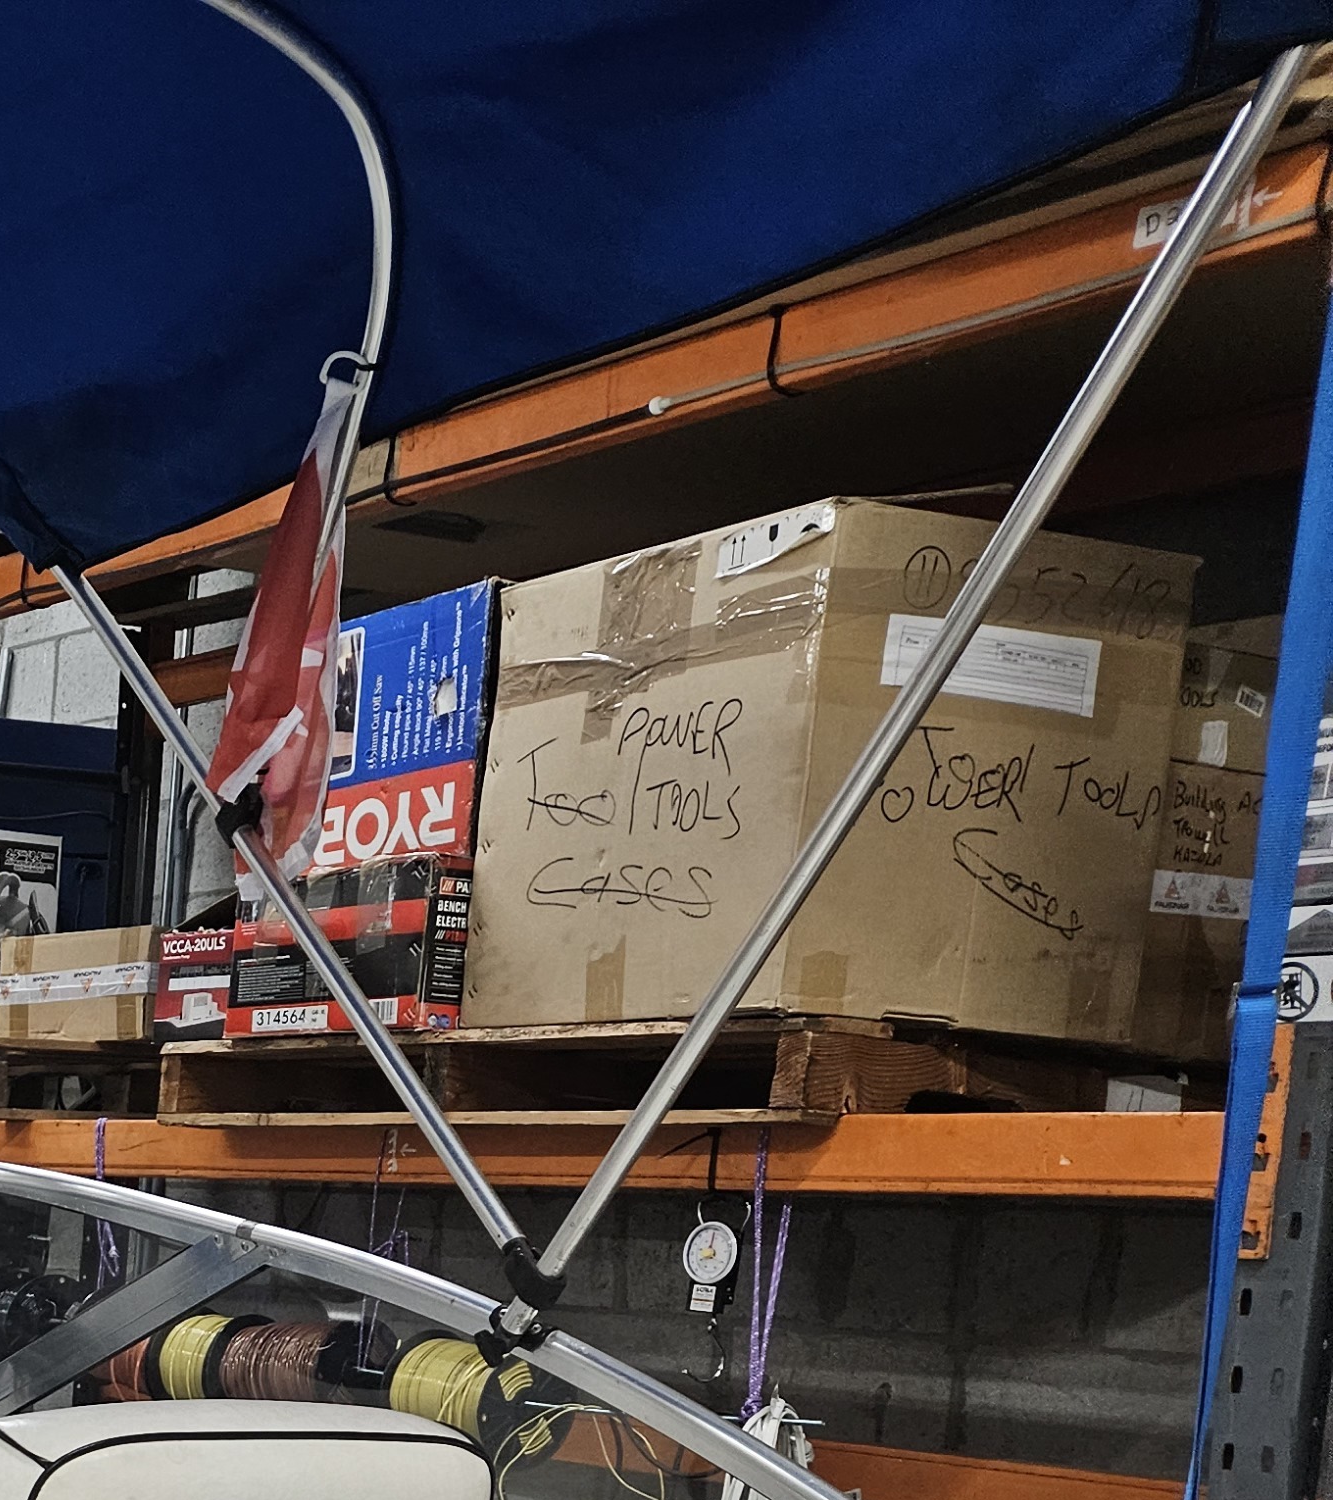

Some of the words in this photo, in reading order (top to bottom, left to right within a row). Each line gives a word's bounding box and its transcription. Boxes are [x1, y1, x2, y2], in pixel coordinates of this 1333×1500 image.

[437, 900, 467, 914] BENCH
[163, 936, 226, 954] VCCA-20ULS
[255, 1008, 306, 1026] 314564
